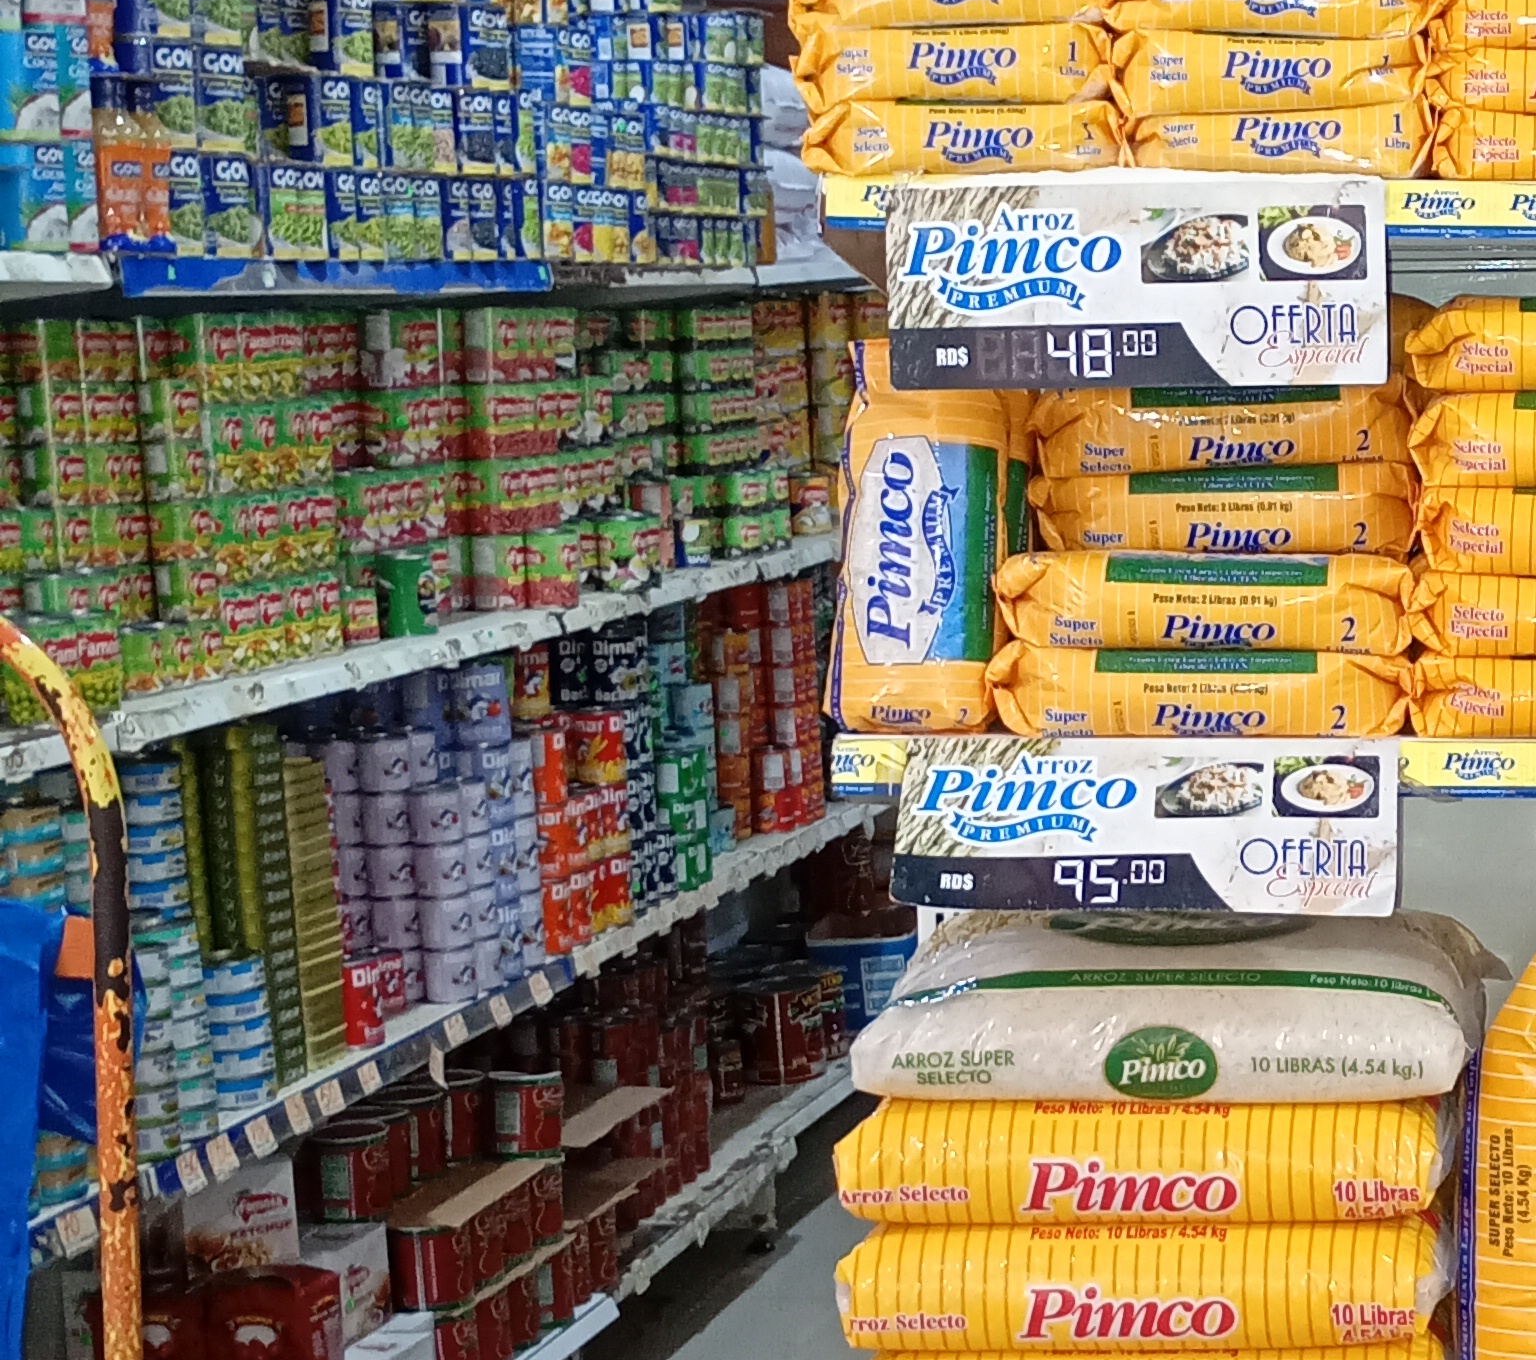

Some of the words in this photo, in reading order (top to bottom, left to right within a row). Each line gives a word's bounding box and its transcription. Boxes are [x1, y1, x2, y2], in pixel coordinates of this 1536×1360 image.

[907, 41, 1017, 71] Pimco
[1221, 51, 1331, 80] Pimco
[1232, 117, 1342, 144] Pimco
[1401, 193, 1476, 211] Pimco
[996, 209, 1075, 233] Arroz
[903, 225, 1121, 276] Pimco
[948, 283, 1076, 309] PREMIUM
[1230, 304, 1357, 344] OFERTA
[936, 347, 969, 368] RD$
[1257, 331, 1368, 377] Especial
[1084, 443, 1125, 458] Super
[1190, 436, 1294, 461] Pimco
[866, 451, 916, 648] Pimco
[1453, 606, 1505, 622] Selecto
[1162, 614, 1275, 642] Pimco
[1450, 622, 1508, 639] Especial
[1152, 704, 1265, 729] Pimco
[1016, 755, 1093, 776] Arroz
[1442, 753, 1515, 772] Pimco
[918, 769, 1138, 812] Pimco
[962, 816, 1088, 841] PREMIUM
[1240, 839, 1366, 878] OFERTA
[940, 872, 973, 890] RD$
[1266, 863, 1376, 900] Especial
[892, 1051, 956, 1069] ARROZ
[961, 1050, 1015, 1067] SUPER
[1118, 1056, 1207, 1085] Pimco
[1250, 1056, 1271, 1072] 10
[1276, 1057, 1336, 1074] LIBRAS
[1341, 1056, 1388, 1078] (4.54
[917, 1070, 992, 1085] SELECTO
[1488, 1135, 1500, 1194] SELECTO
[899, 1185, 969, 1203] Selecto
[1023, 1160, 1238, 1213] Pimco
[1334, 1183, 1358, 1202] 10
[1364, 1183, 1420, 1203] Libras
[1488, 1198, 1500, 1247] SUPER
[1019, 1287, 1236, 1339] Pimco
